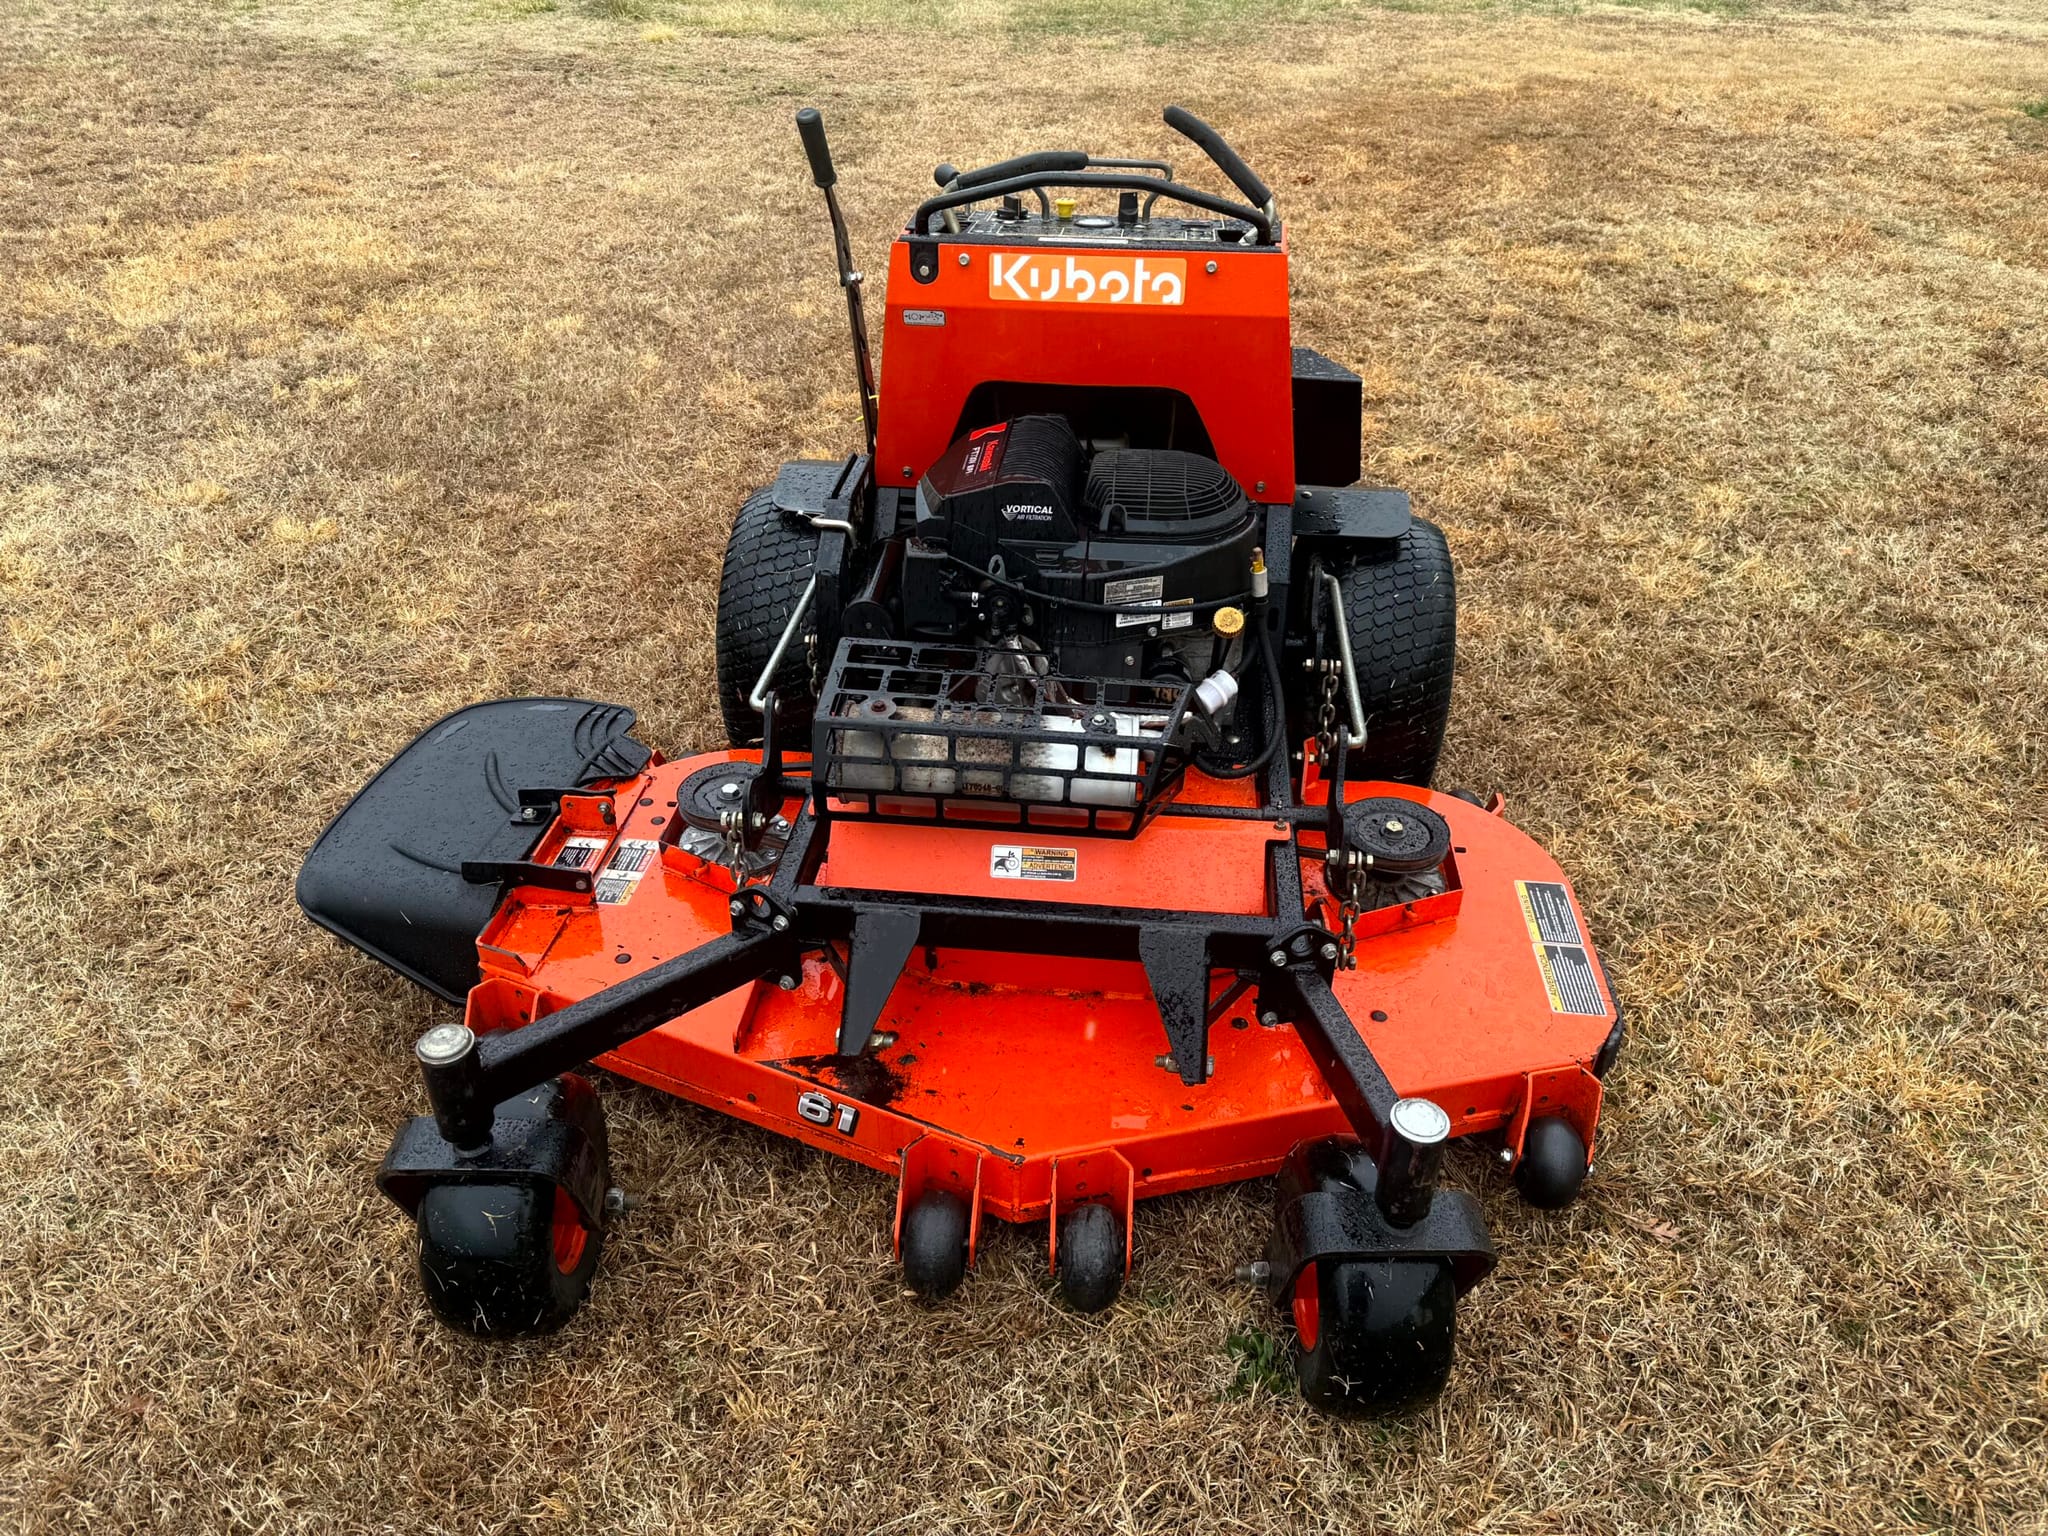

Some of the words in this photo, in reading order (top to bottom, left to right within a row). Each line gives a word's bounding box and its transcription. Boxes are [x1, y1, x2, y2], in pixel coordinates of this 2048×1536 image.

[993, 254, 1182, 304] Kubota
[1006, 504, 1053, 514] VORTICAL
[1034, 848, 1069, 857] WARNING
[1029, 862, 1073, 871] ADVERTENCIA
[1538, 953, 1557, 997] ADVERTENCIA
[798, 1091, 858, 1135] 61
